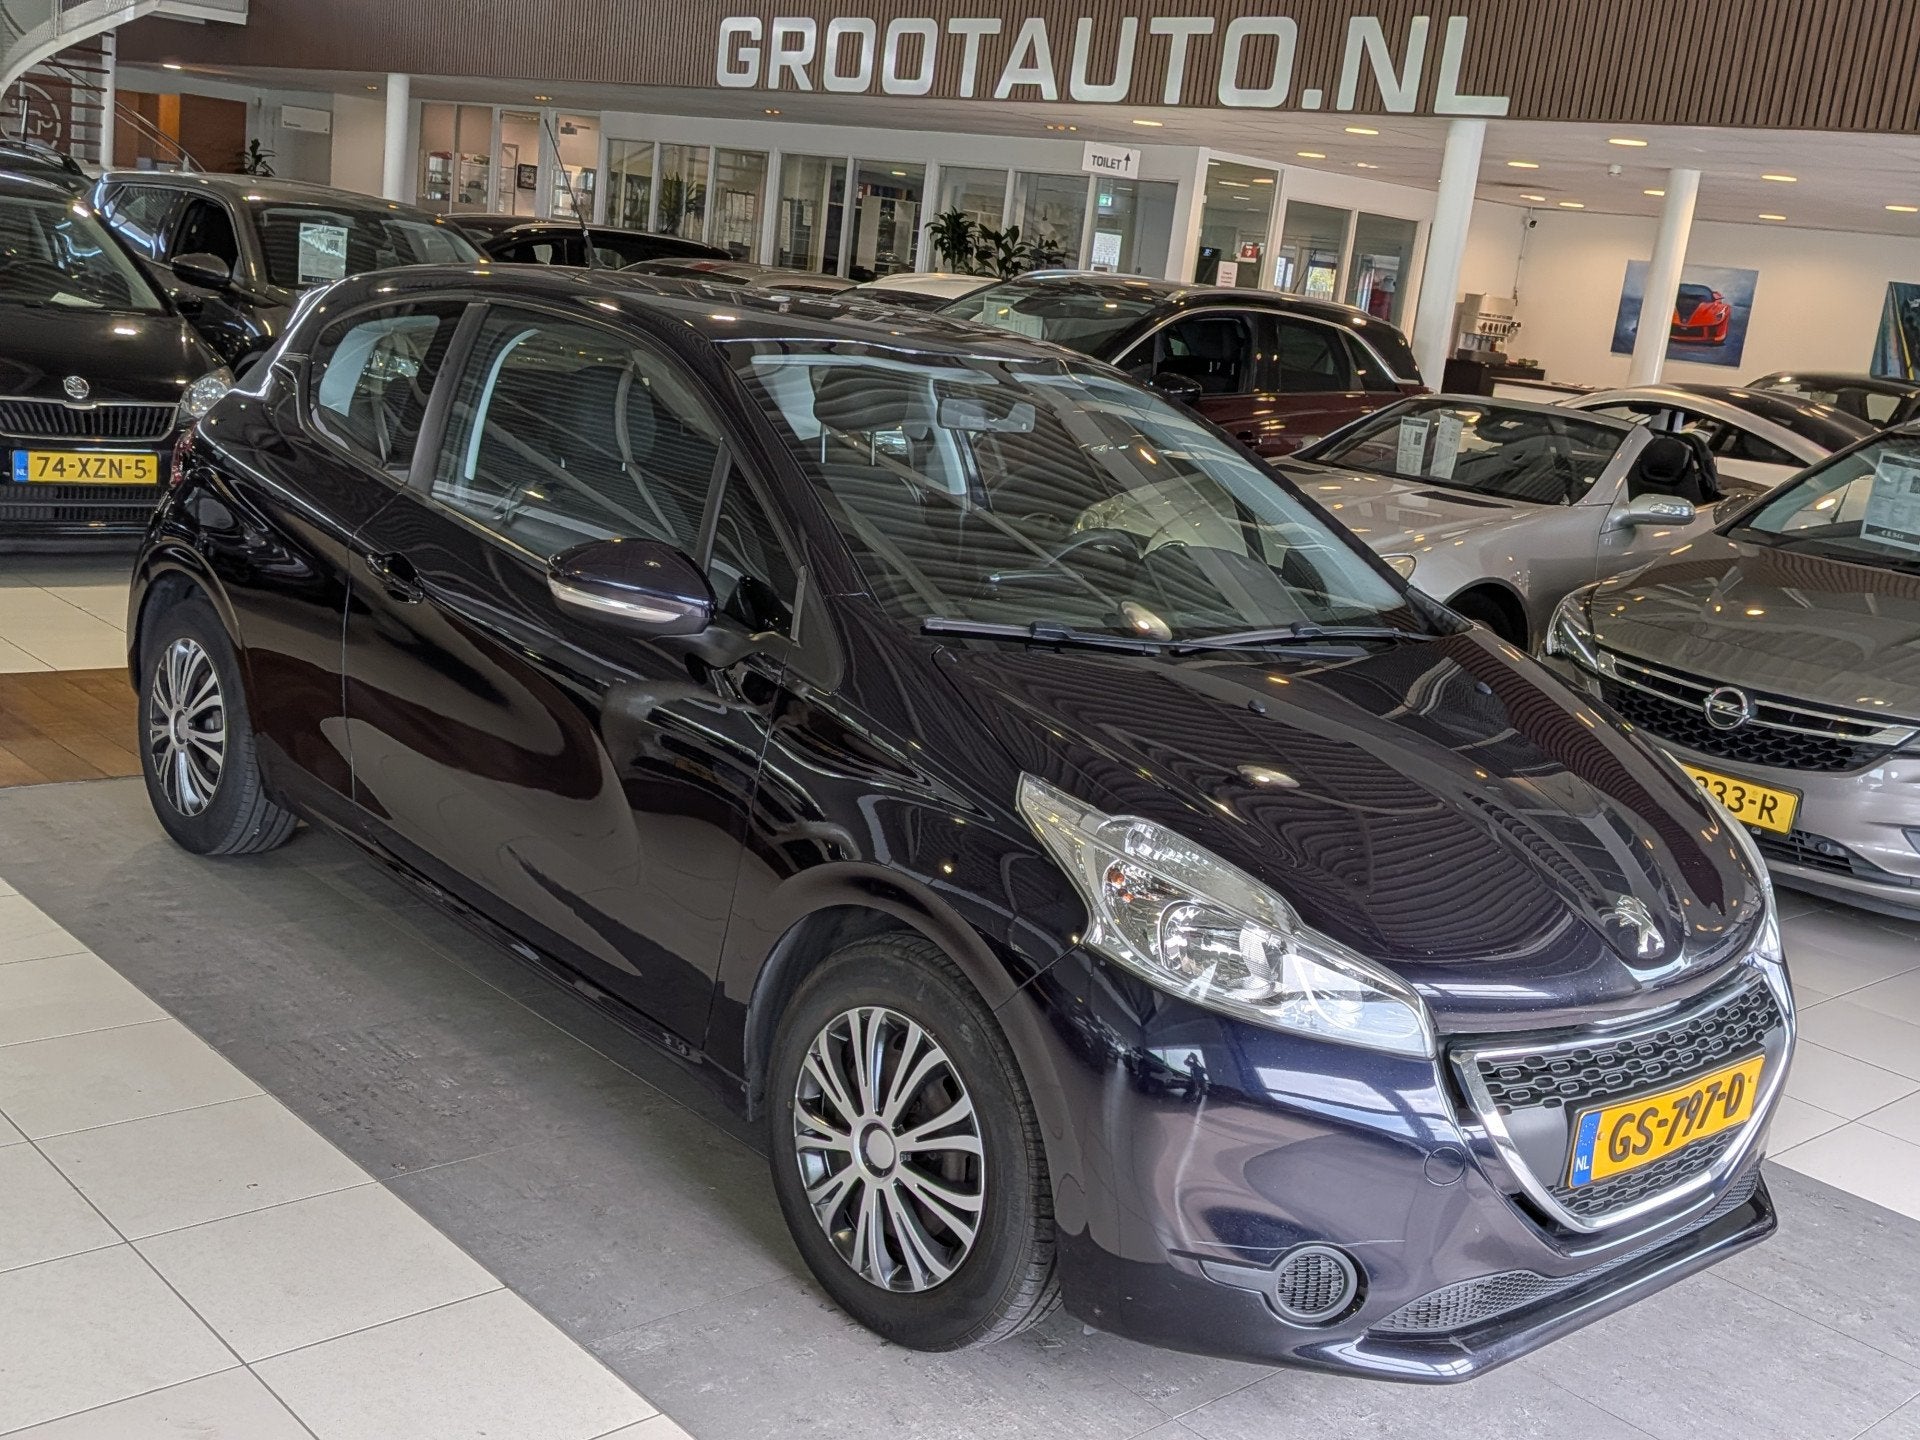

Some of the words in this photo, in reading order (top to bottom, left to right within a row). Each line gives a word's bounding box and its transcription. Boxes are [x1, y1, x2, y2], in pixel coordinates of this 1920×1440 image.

[716, 16, 1511, 116] GROOTAUTO.NL
[1091, 154, 1122, 170] TOILET
[16, 468, 27, 476] NL
[36, 456, 147, 479] 74-XZN-5
[1608, 1072, 1746, 1163] GS-797-D
[1575, 1156, 1590, 1173] NL
